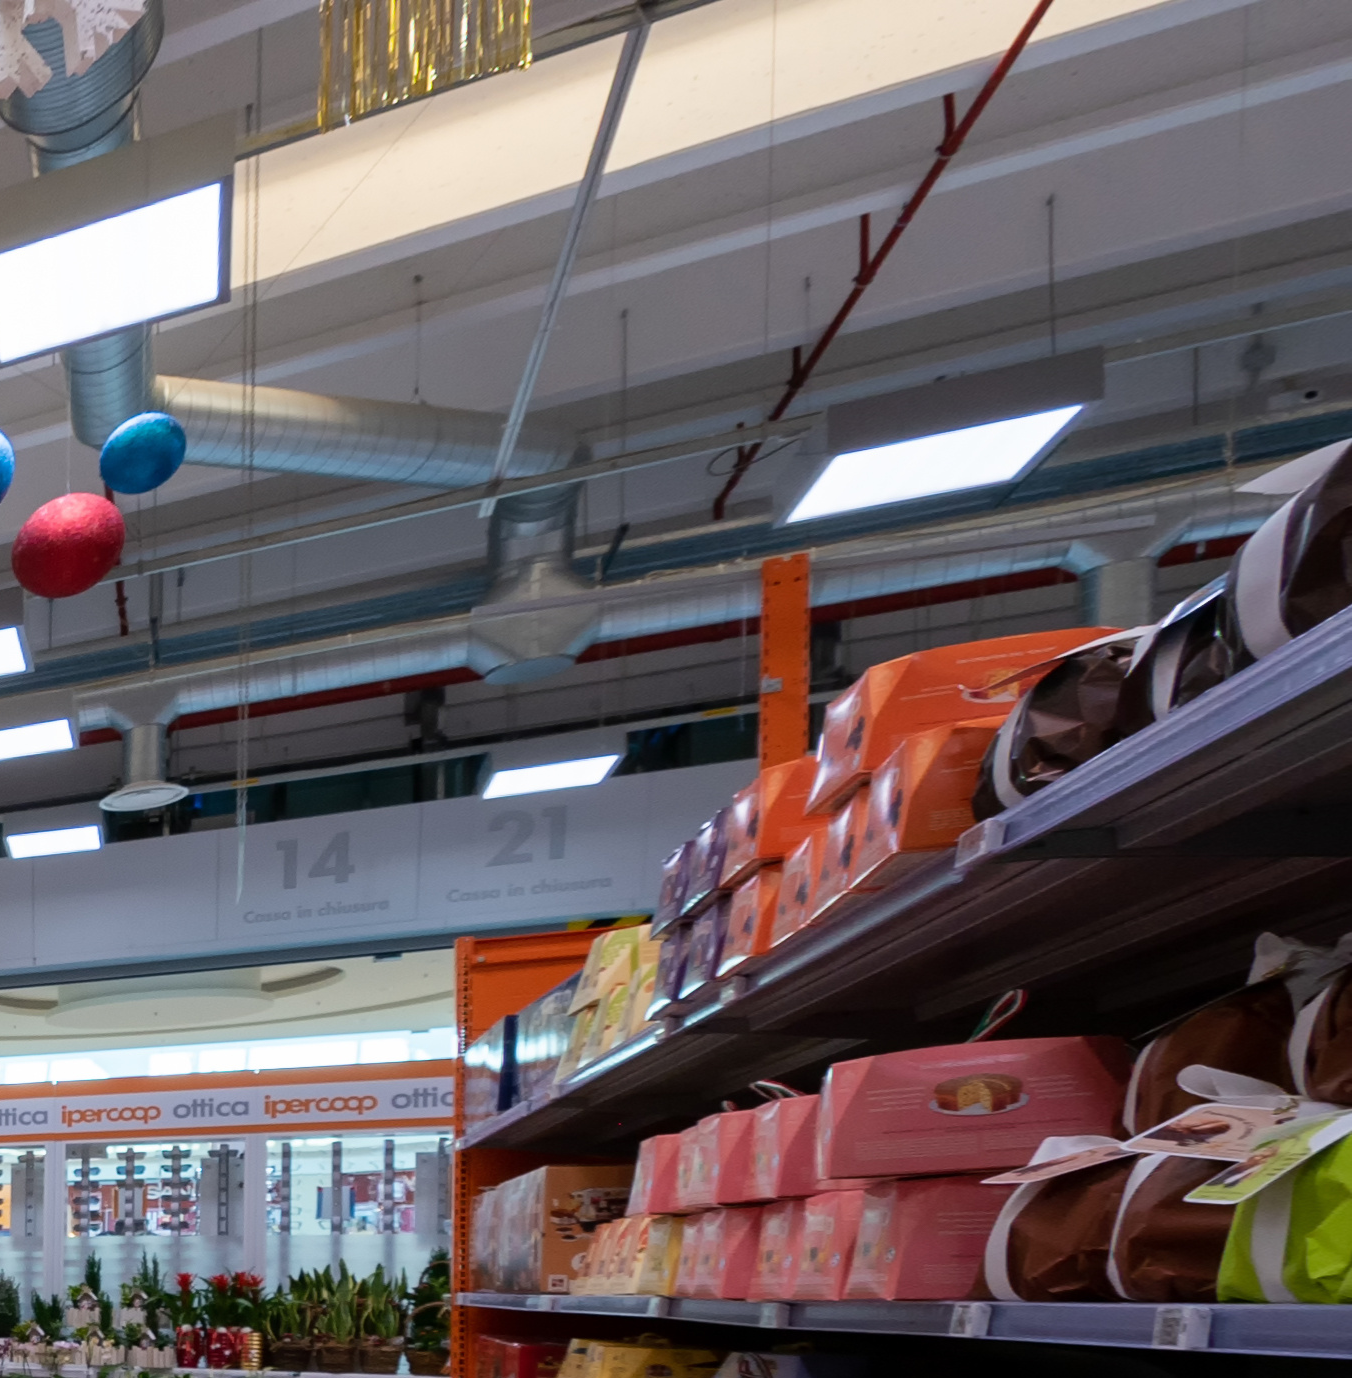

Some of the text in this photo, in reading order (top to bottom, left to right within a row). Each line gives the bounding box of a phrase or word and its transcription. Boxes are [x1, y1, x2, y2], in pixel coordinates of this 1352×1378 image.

[277, 832, 356, 889] 14
[485, 805, 568, 868] 21
[61, 1104, 161, 1127] ipercoop
[172, 1099, 249, 1119] ottica
[264, 1094, 377, 1115] ipercoop
